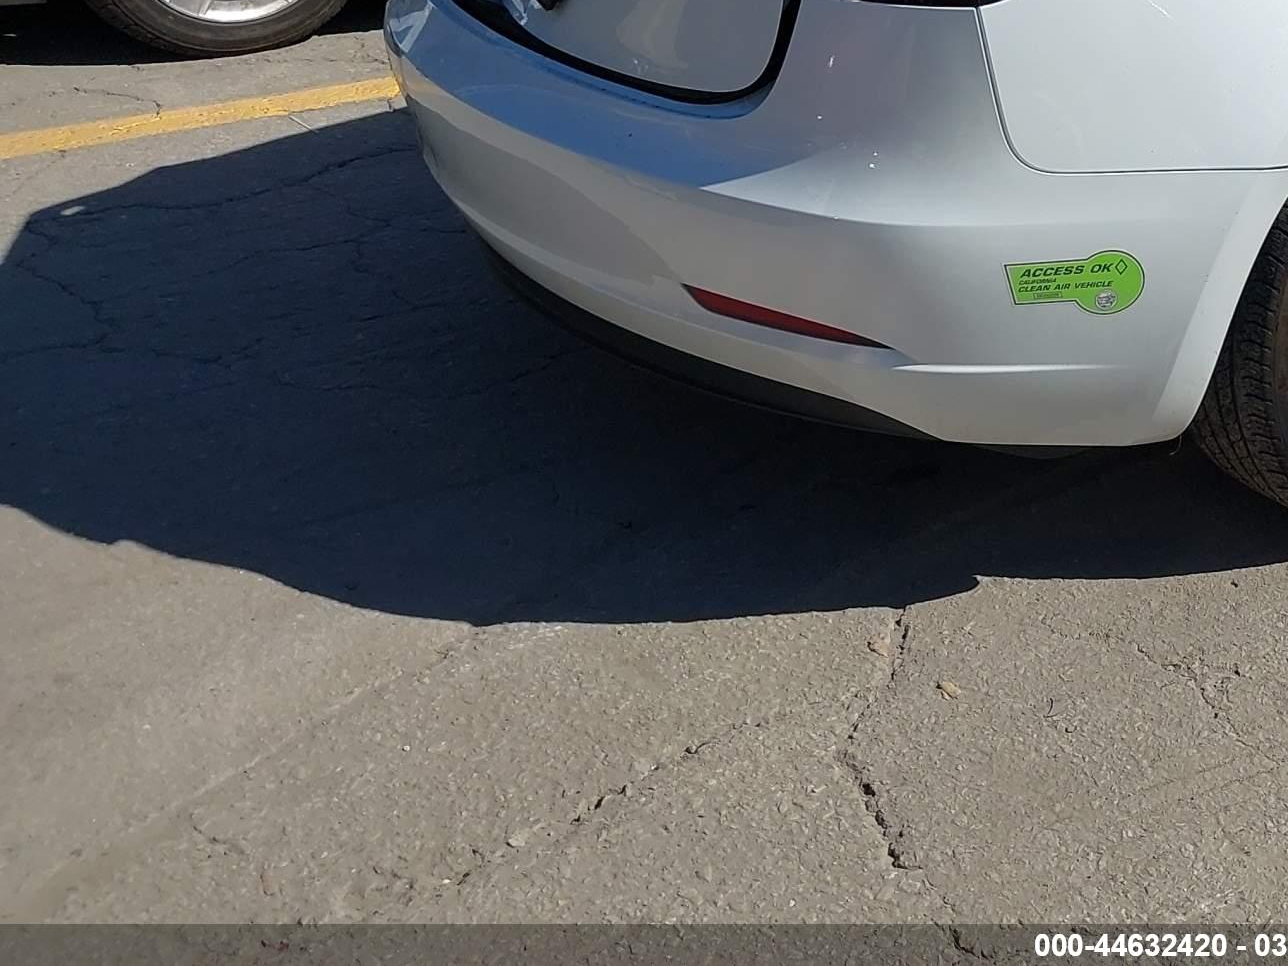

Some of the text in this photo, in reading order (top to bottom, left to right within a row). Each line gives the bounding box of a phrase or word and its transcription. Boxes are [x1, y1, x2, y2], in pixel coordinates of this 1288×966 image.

[1020, 263, 1114, 278] ACCESS OK
[1018, 280, 1114, 293] CLEAN AIR VEHICLE
